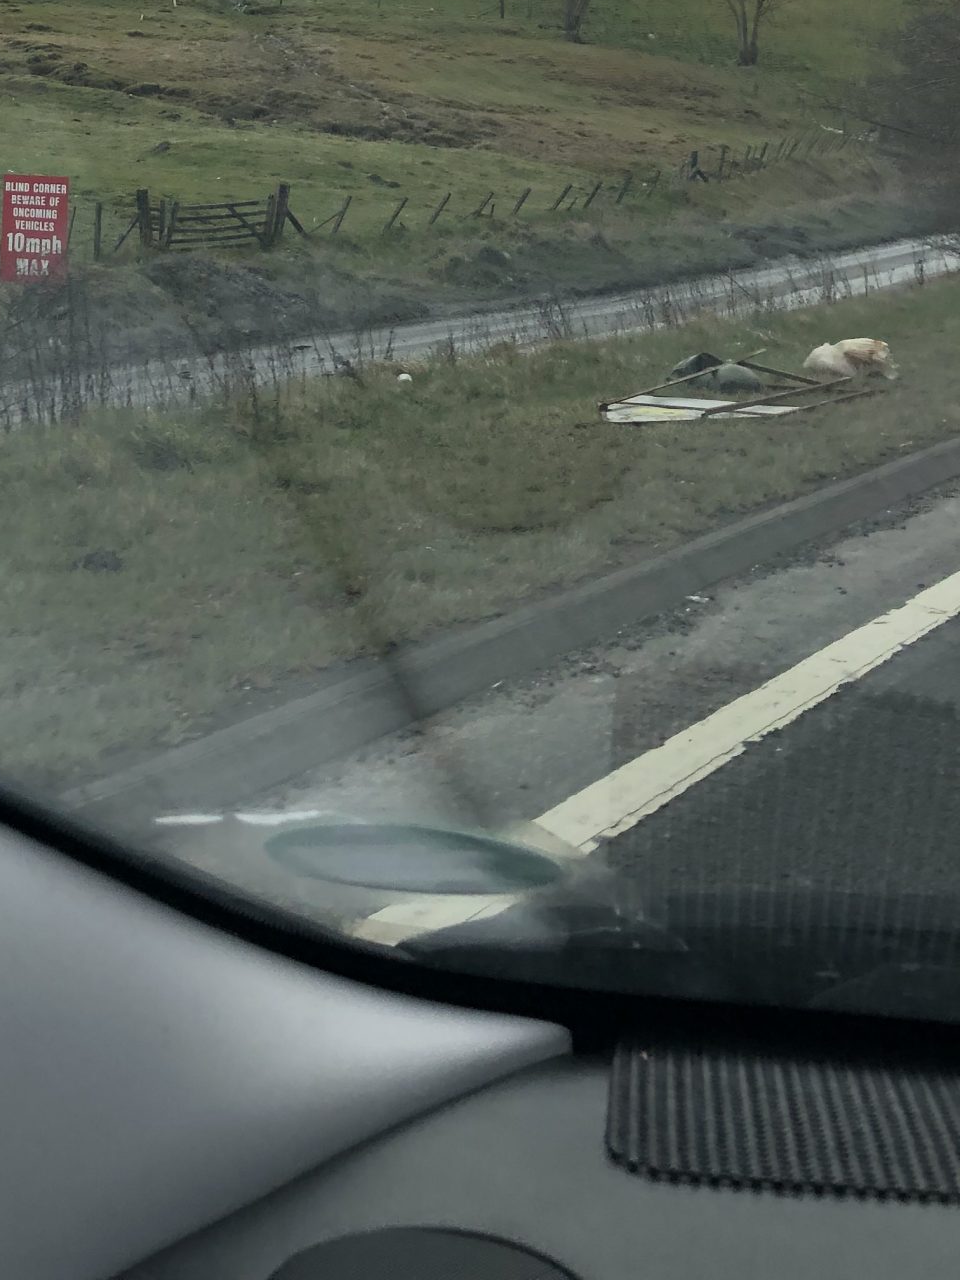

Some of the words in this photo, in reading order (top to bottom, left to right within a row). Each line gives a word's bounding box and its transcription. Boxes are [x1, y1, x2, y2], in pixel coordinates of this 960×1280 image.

[5, 182, 30, 192] BLIND
[33, 183, 67, 194] CORNER
[11, 195, 46, 205] BEWARE
[49, 197, 60, 206] OF
[13, 207, 58, 219] ONCOMING
[15, 220, 55, 231] VEHICLES
[16, 258, 50, 276] MAX
